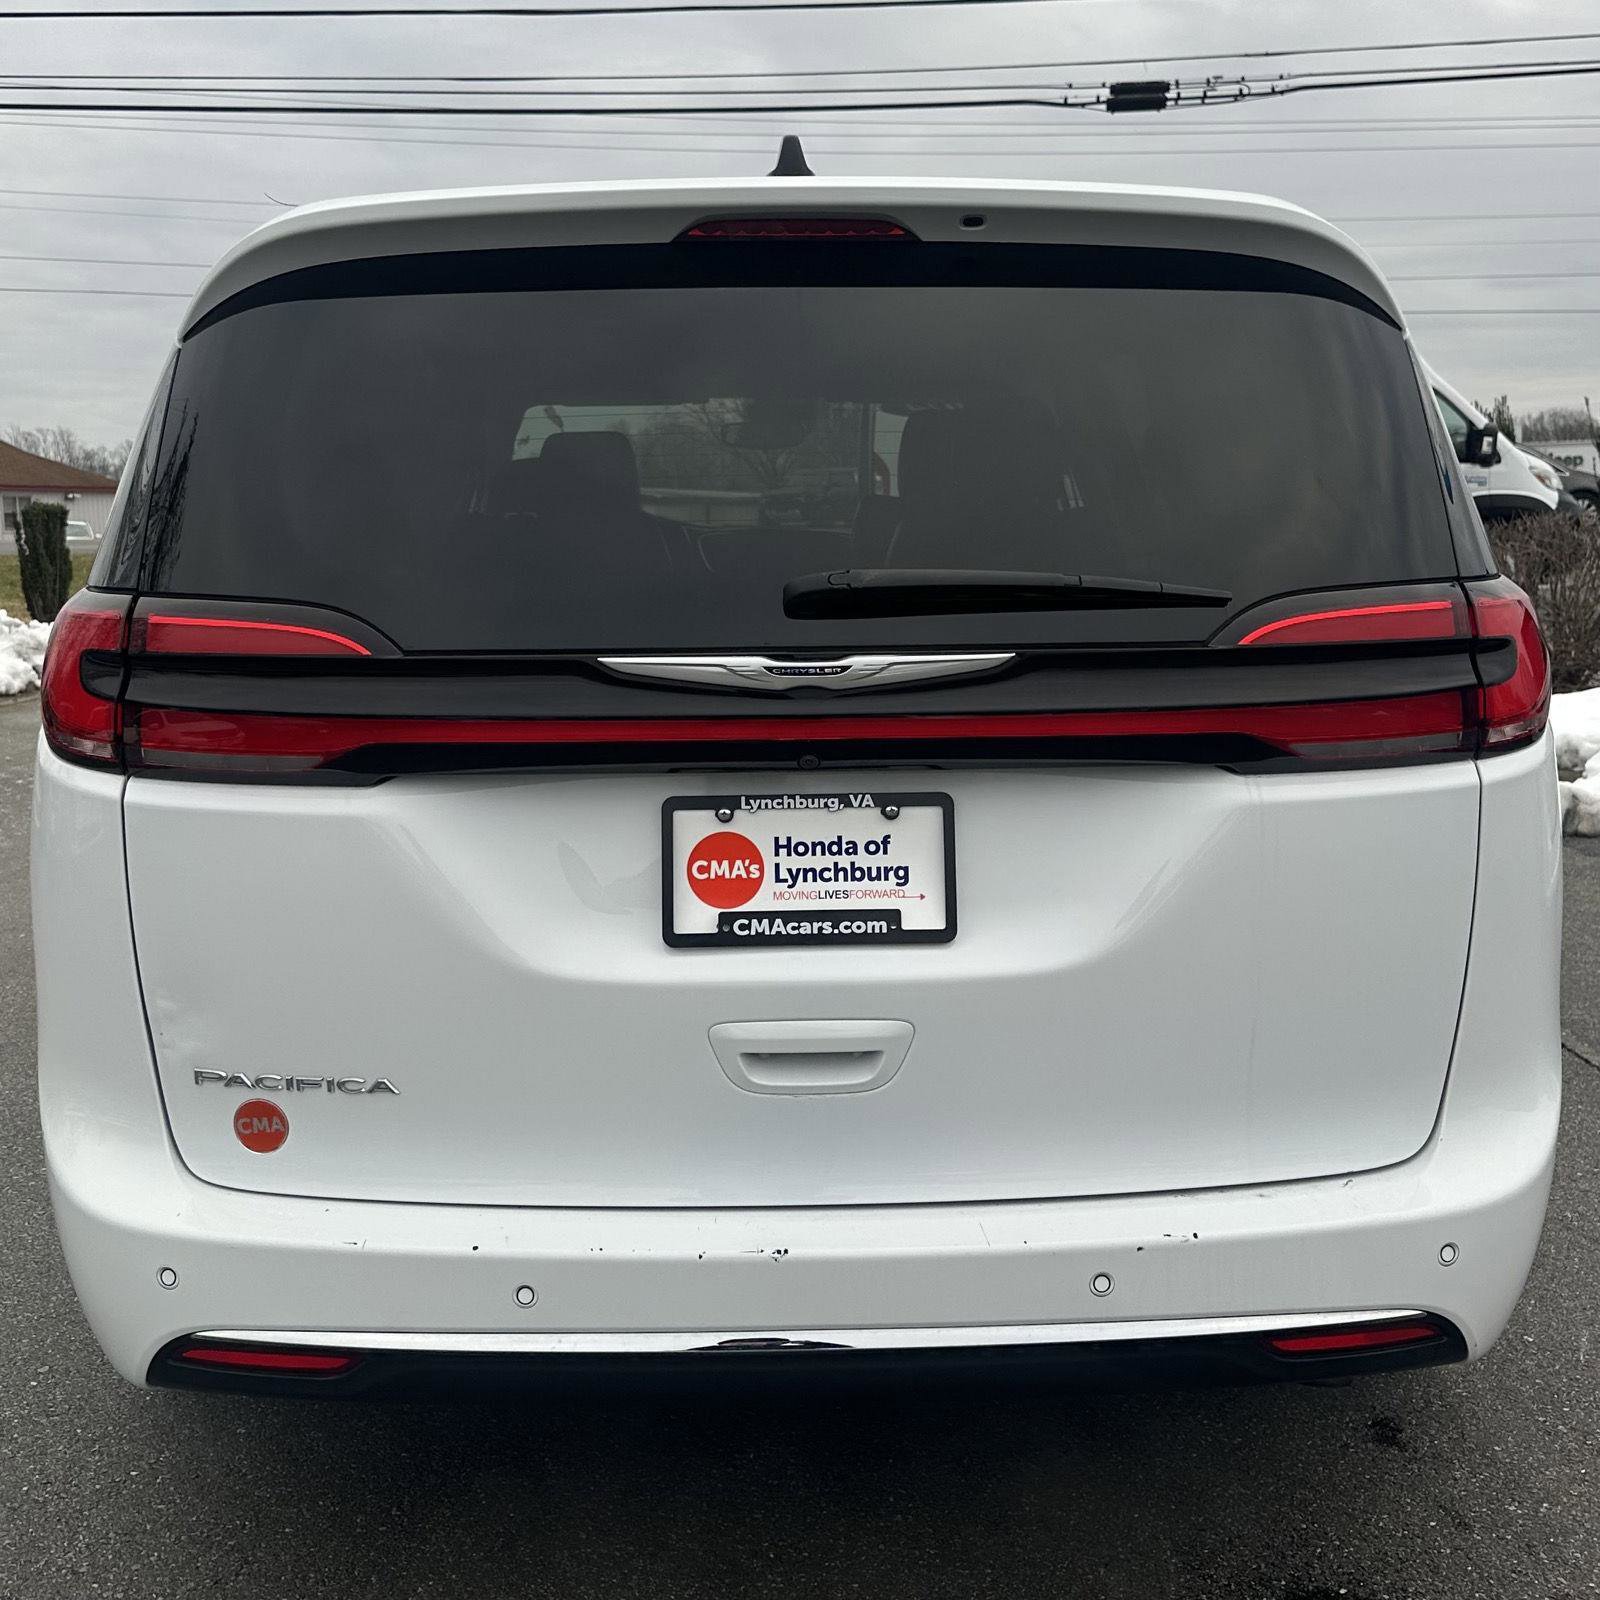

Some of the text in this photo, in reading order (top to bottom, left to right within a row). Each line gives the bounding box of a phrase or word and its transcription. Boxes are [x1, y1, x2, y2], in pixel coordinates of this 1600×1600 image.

[772, 667, 842, 675] CHRYSLER
[740, 794, 875, 812] Lynchburg, VA
[773, 834, 891, 857] Honda of
[691, 858, 760, 880] CMA's
[773, 862, 910, 889] Lynchburg
[732, 918, 888, 936] CMAcars.com
[193, 1066, 401, 1095] PACIFICA
[236, 1116, 286, 1135] CMA
